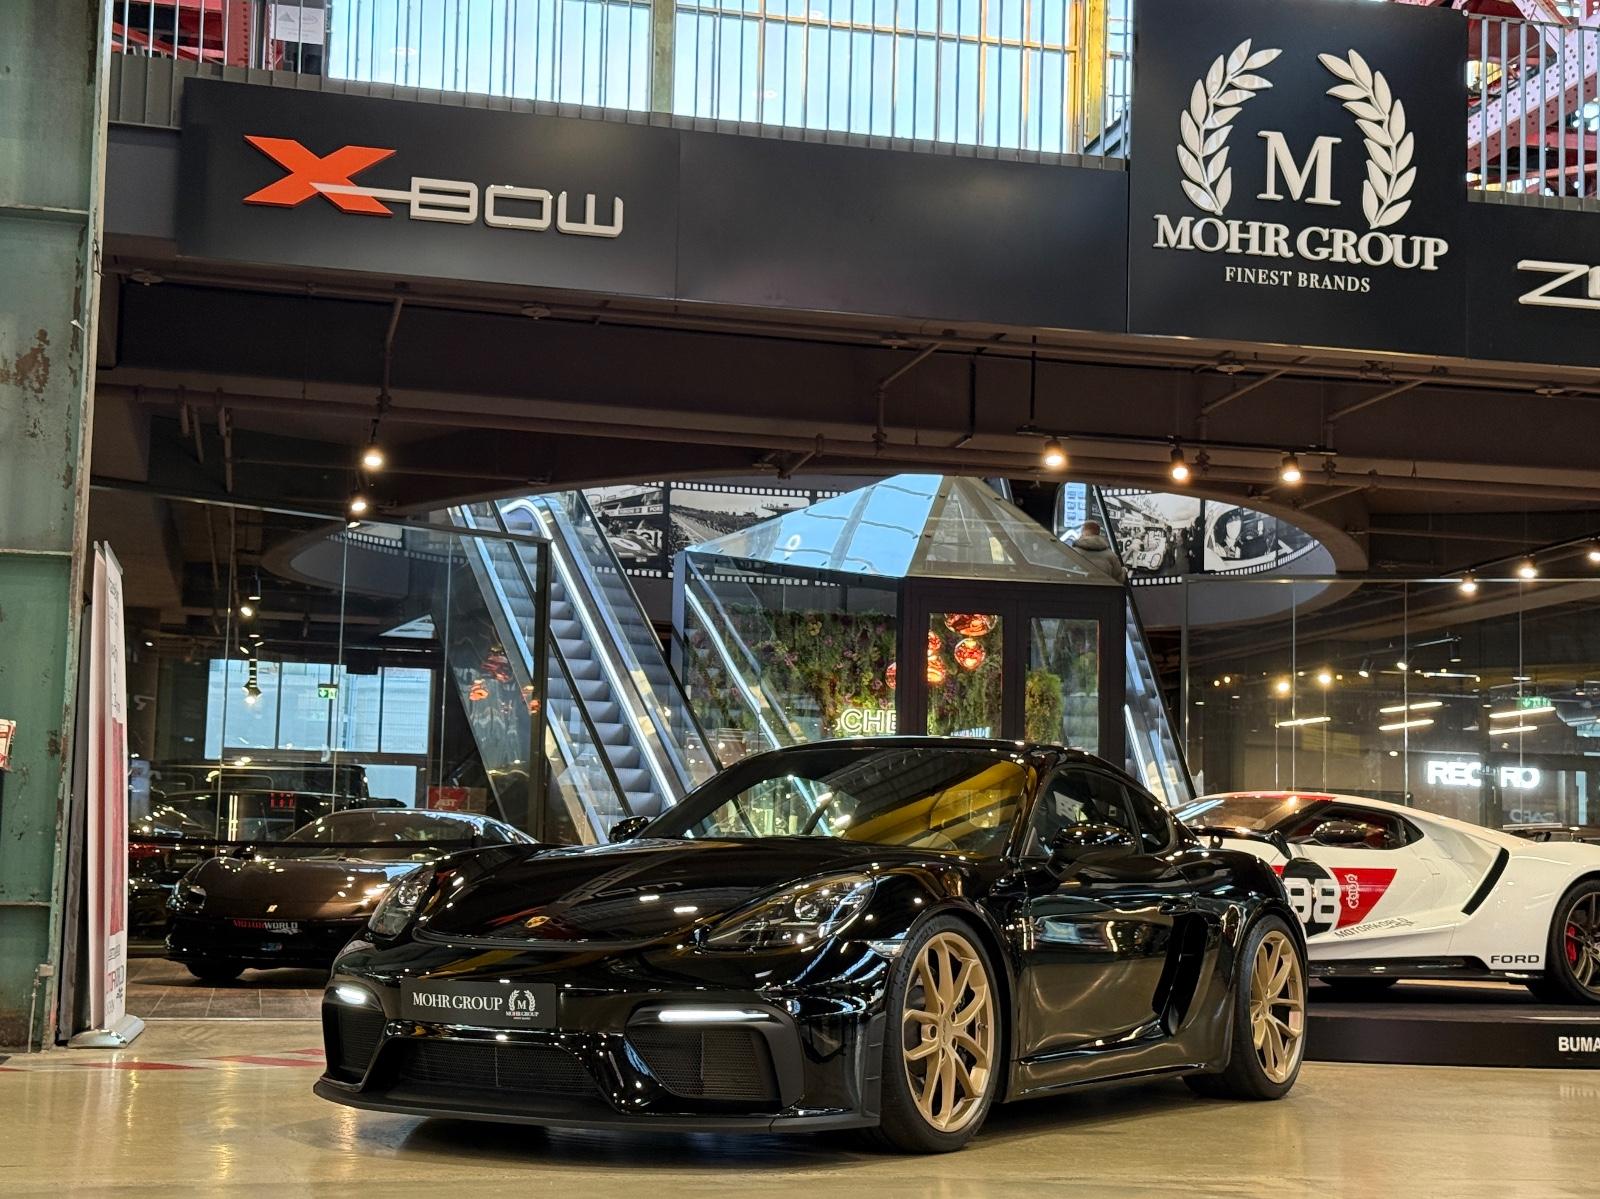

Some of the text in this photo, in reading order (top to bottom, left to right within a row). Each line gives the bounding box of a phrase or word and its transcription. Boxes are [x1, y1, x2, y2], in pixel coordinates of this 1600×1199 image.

[1257, 130, 1342, 206] M
[1153, 214, 1449, 271] MOHR GROUP
[1225, 266, 1371, 293] FINEST BRANDS
[1427, 760, 1541, 789] RECRO
[1490, 954, 1540, 964] FORD
[412, 992, 503, 1011] MOHR GROUP
[517, 1000, 527, 1010] M
